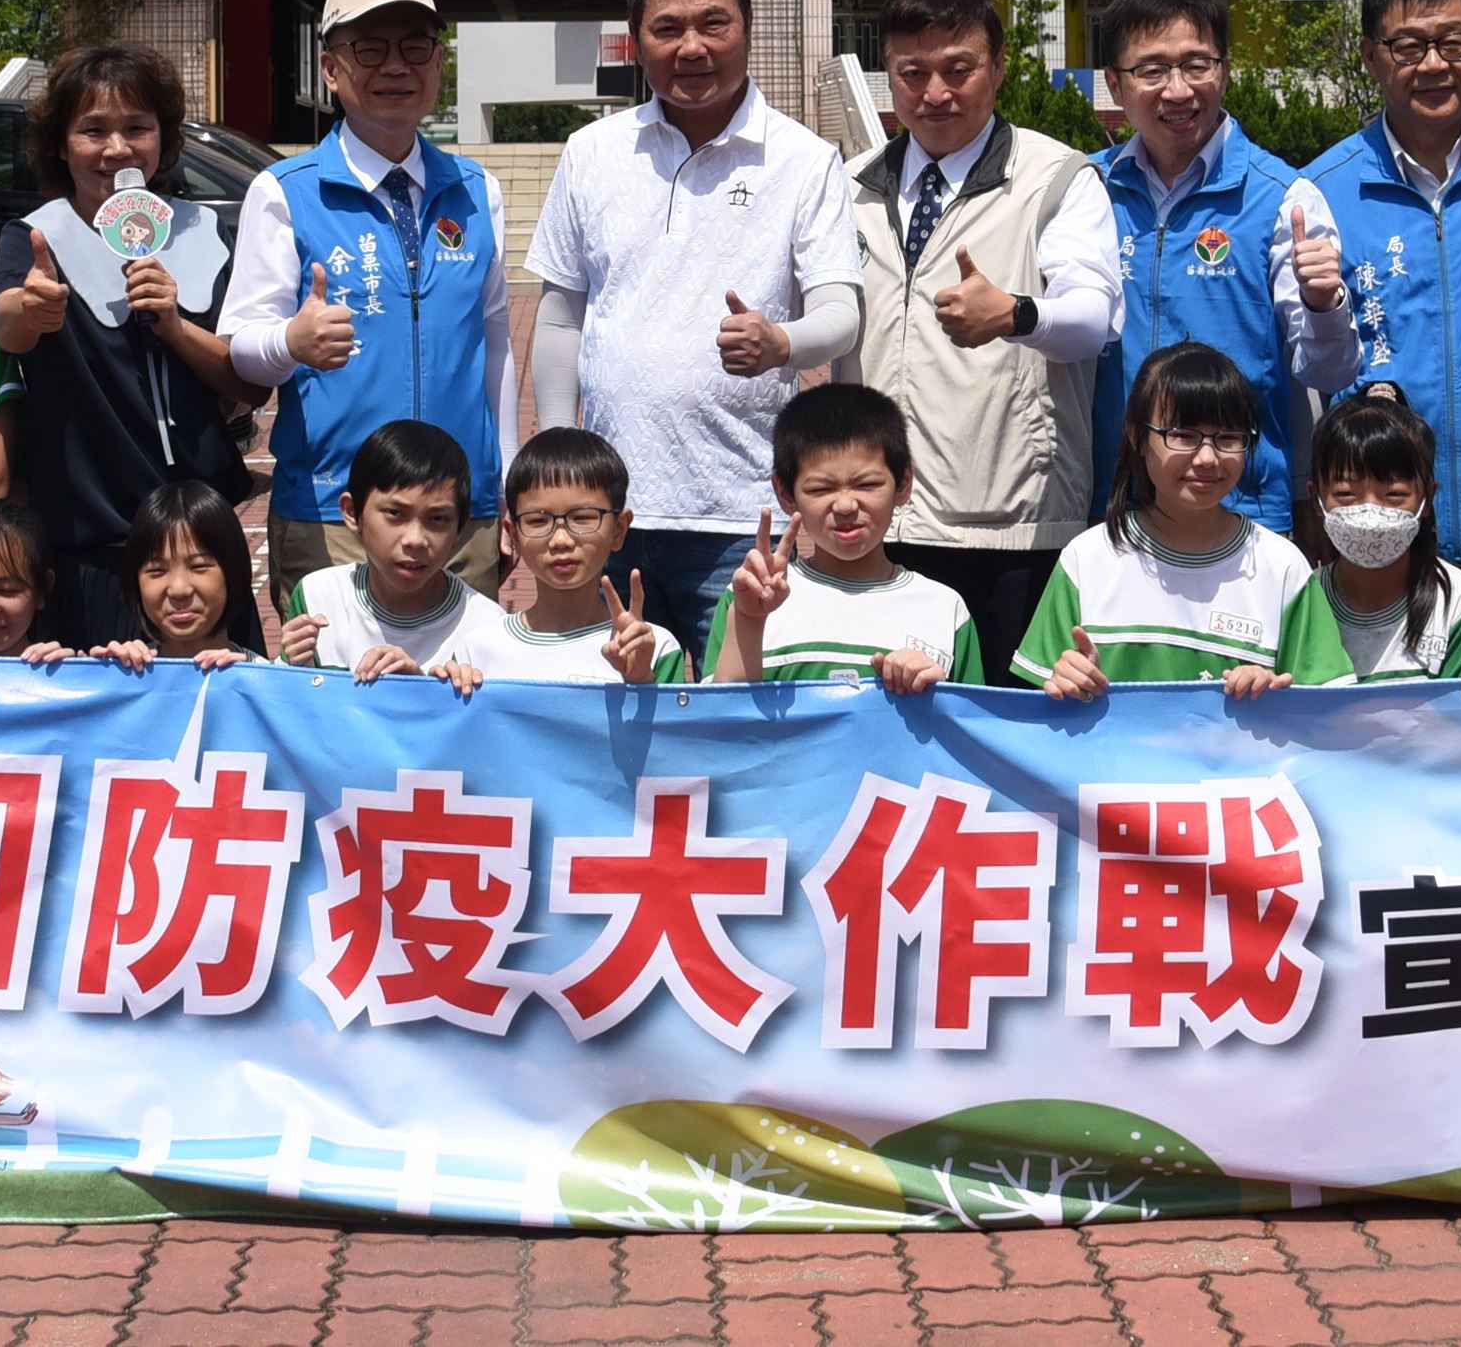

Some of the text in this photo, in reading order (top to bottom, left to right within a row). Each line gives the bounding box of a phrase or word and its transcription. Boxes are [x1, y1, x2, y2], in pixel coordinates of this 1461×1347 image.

[97, 193, 172, 226] 校園防疫大作戰
[358, 232, 386, 316] 苗栗市長
[1386, 235, 1409, 278] 局長
[327, 245, 363, 356] 余文
[1354, 261, 1392, 367] 陳華盛
[1226, 619, 1260, 637] 5216
